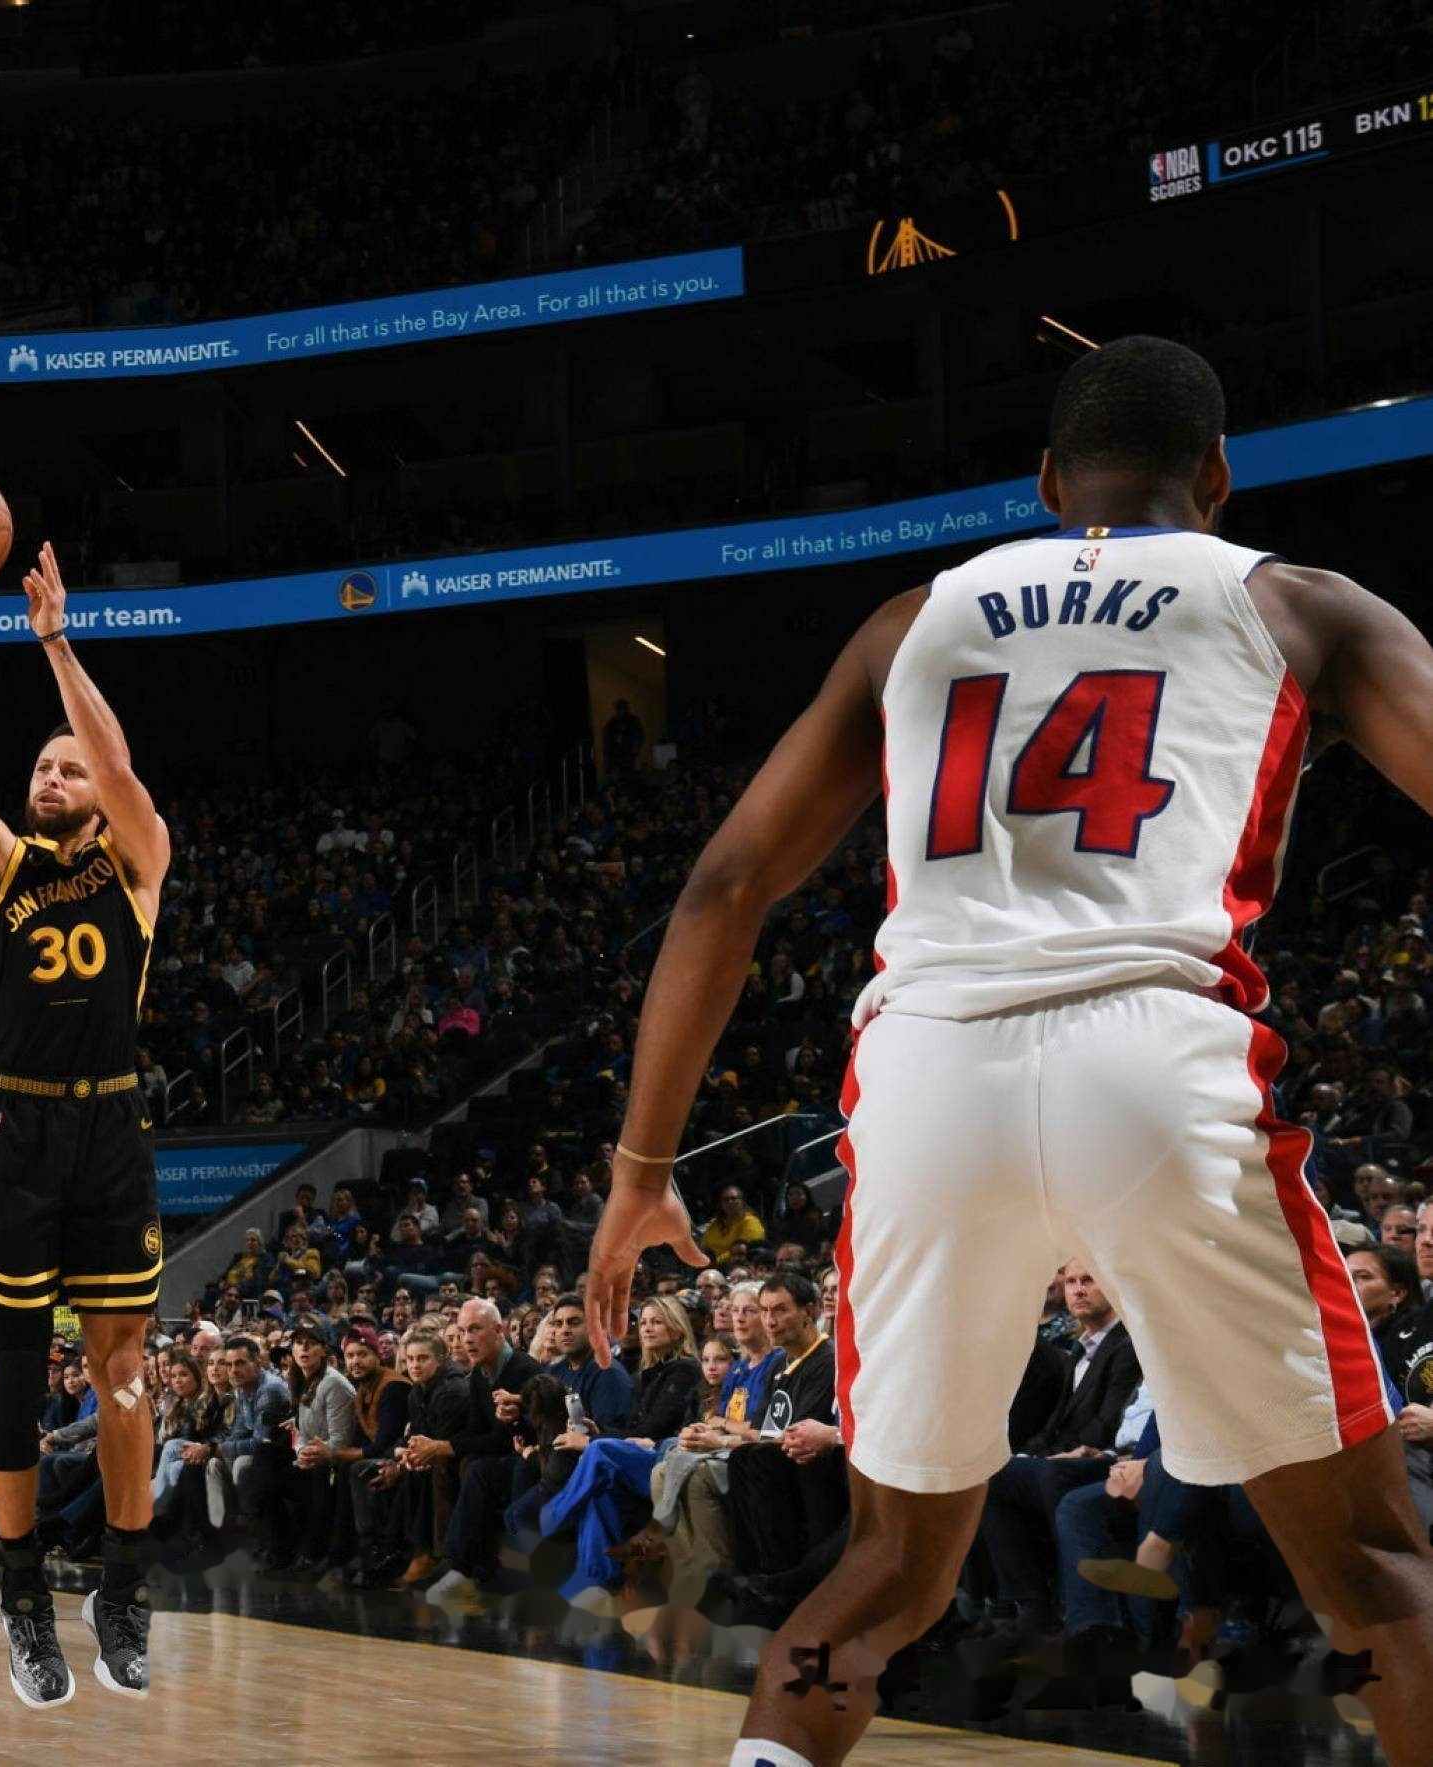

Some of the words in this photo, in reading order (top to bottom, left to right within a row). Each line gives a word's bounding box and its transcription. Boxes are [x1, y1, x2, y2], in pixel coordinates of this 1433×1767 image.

[1355, 102, 1412, 134] BKN
[1166, 144, 1200, 181] NBA
[1224, 137, 1277, 168] OKC
[1282, 122, 1323, 157] 115
[1149, 175, 1202, 203] SCORES
[267, 332, 300, 352] For
[303, 325, 325, 347] all
[331, 323, 368, 343] that
[374, 318, 389, 337] is
[394, 312, 426, 334] the
[432, 309, 469, 333] Bay
[474, 302, 527, 322] Area.
[537, 294, 570, 314] For
[577, 287, 600, 308] all
[606, 283, 647, 304] that
[652, 279, 668, 298] is
[674, 277, 720, 301] you.
[46, 351, 106, 371] KAISER
[721, 544, 756, 564] For
[762, 538, 786, 559] all
[792, 534, 833, 556] that
[839, 532, 856, 550] is
[861, 526, 894, 547] the
[898, 520, 936, 542] Bay
[940, 512, 993, 533] Area.
[1004, 499, 1039, 520] For
[436, 573, 491, 594] KAISER
[59, 611, 99, 629] our
[103, 605, 182, 626] team.
[977, 579, 1180, 639] BURKS
[926, 669, 1175, 860] 14
[6, 890, 40, 933] SAN
[36, 857, 114, 909] FRANCISCO
[28, 922, 107, 984] 30
